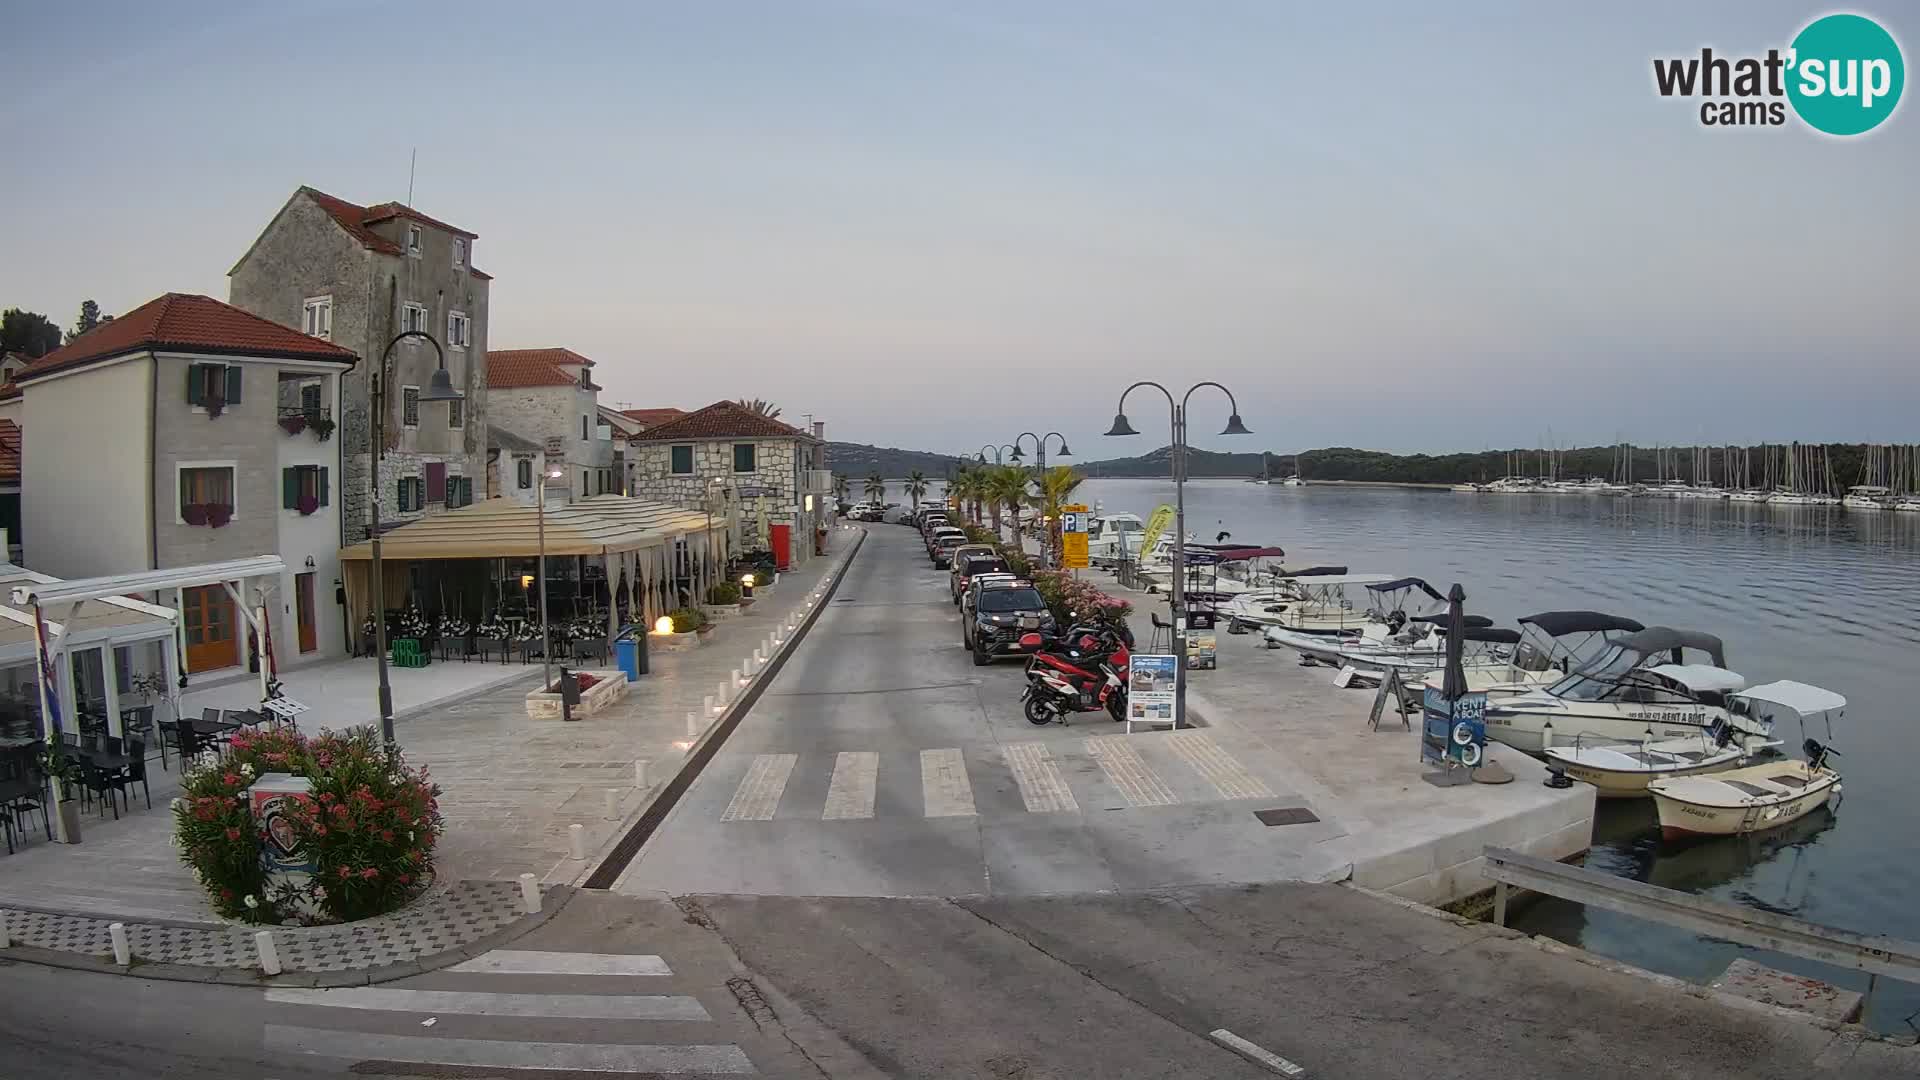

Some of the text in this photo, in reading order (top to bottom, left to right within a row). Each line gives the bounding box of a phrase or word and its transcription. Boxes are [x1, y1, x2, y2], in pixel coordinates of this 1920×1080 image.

[1065, 514, 1076, 531] P
[1453, 698, 1484, 710] RENT
[1453, 710, 1483, 719] A BOAT
[1661, 712, 1681, 721] RENT
[1687, 713, 1706, 725] BOAT
